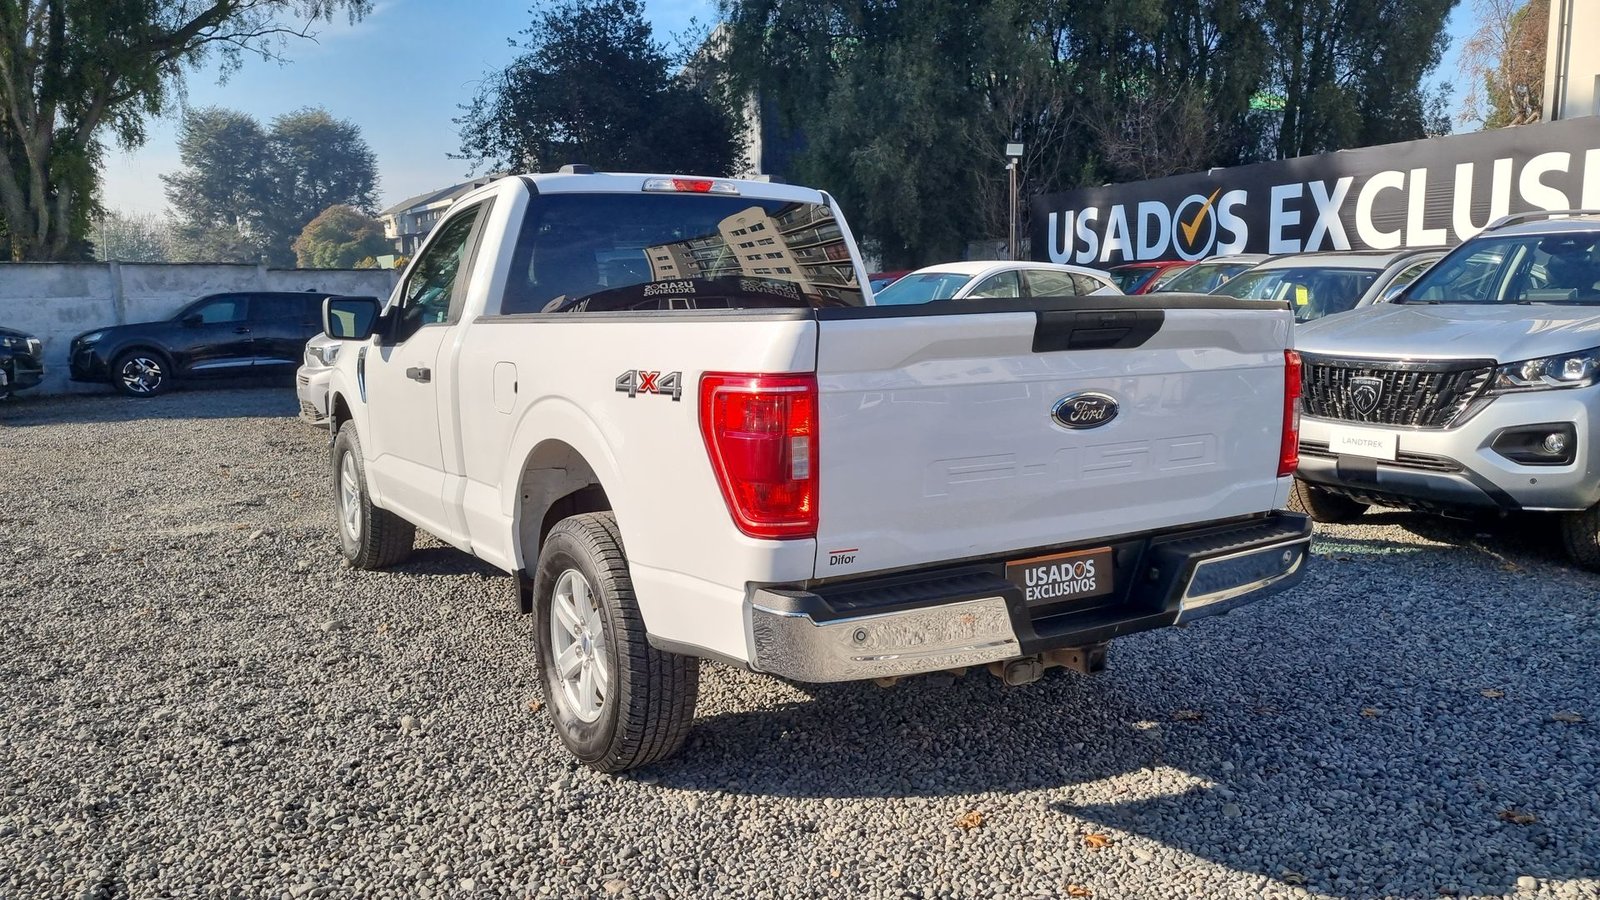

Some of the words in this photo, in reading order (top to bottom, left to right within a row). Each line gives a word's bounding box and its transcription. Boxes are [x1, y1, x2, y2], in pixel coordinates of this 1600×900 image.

[1048, 188, 1248, 265] USADOS
[1070, 400, 1106, 422] Ford
[1342, 437, 1384, 448] LANDTREK
[829, 554, 856, 566] Difor
[1025, 559, 1096, 587] USADOS
[1025, 577, 1097, 601] EXCLUSIVOS
